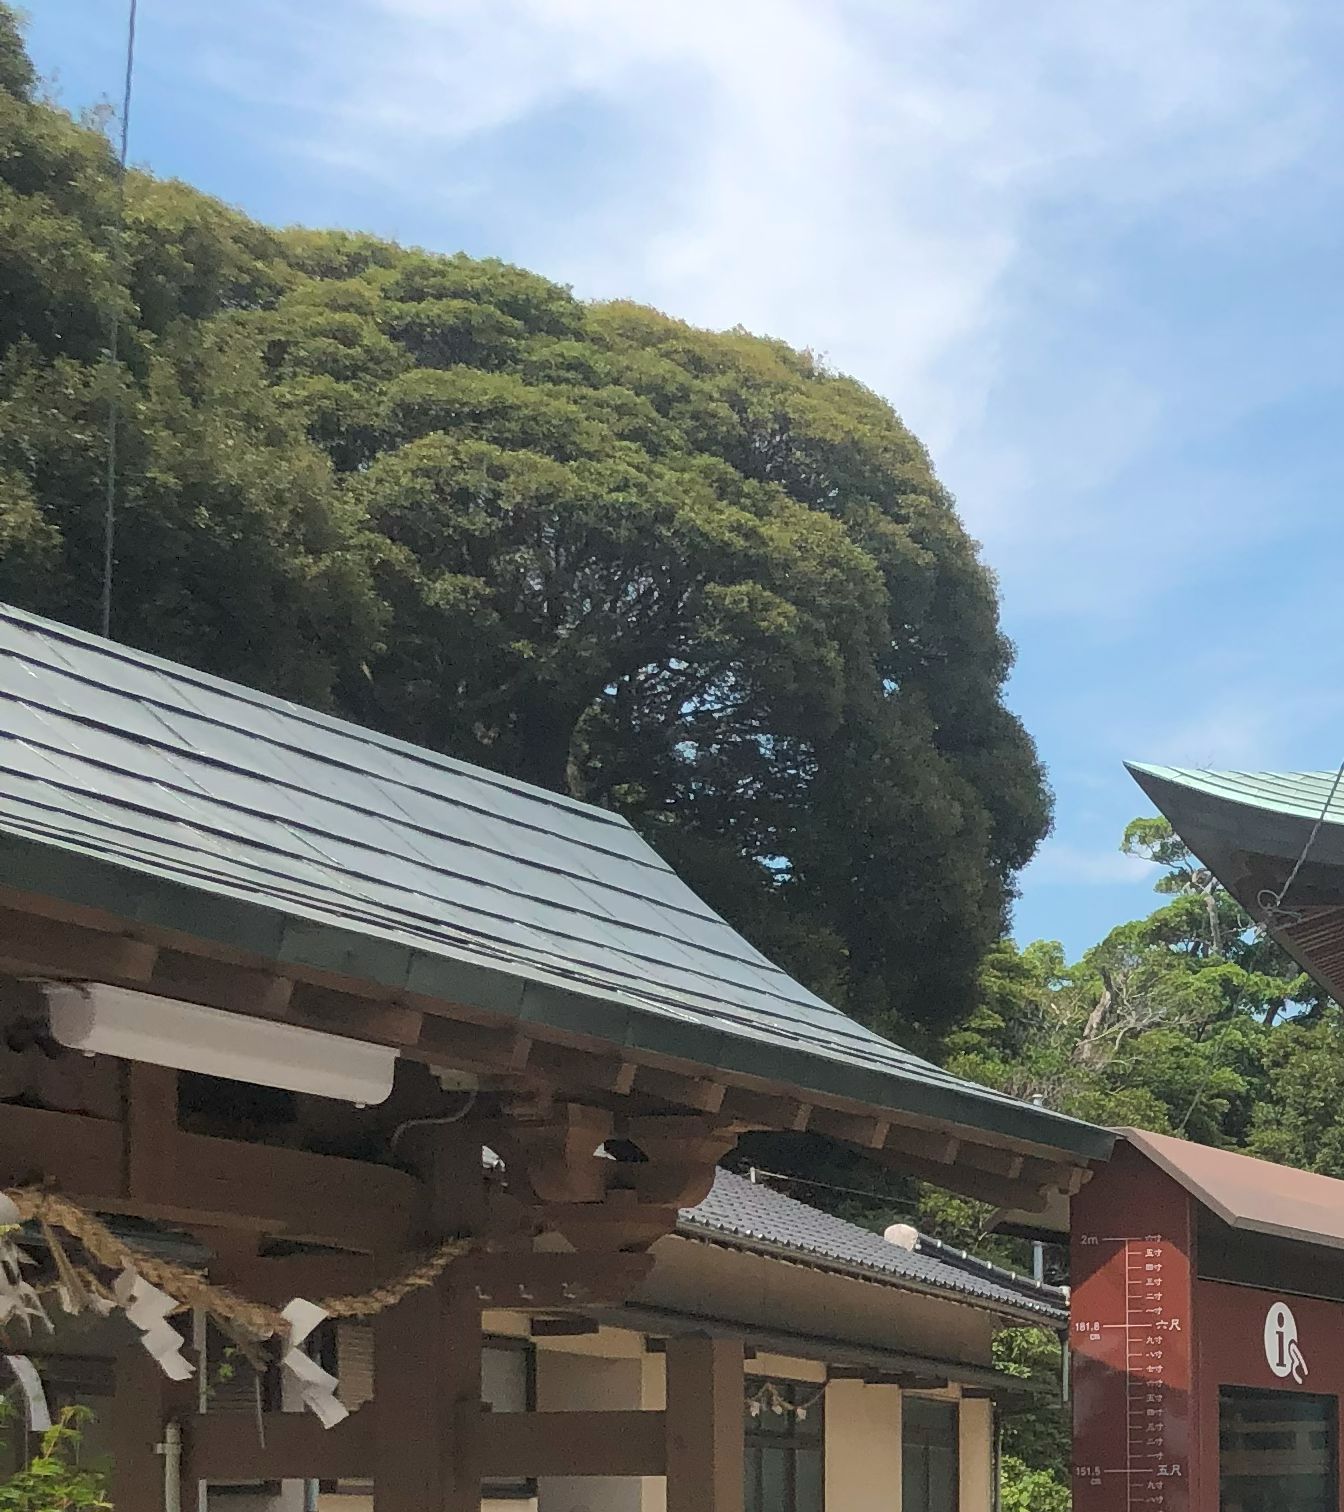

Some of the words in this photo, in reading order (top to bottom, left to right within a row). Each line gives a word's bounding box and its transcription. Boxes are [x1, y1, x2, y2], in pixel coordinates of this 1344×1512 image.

[1081, 1235, 1098, 1244] 2m
[1146, 1292, 1163, 1300] 二寸
[1156, 1319, 1181, 1331] 六尺
[1157, 1464, 1182, 1476] 五尺
